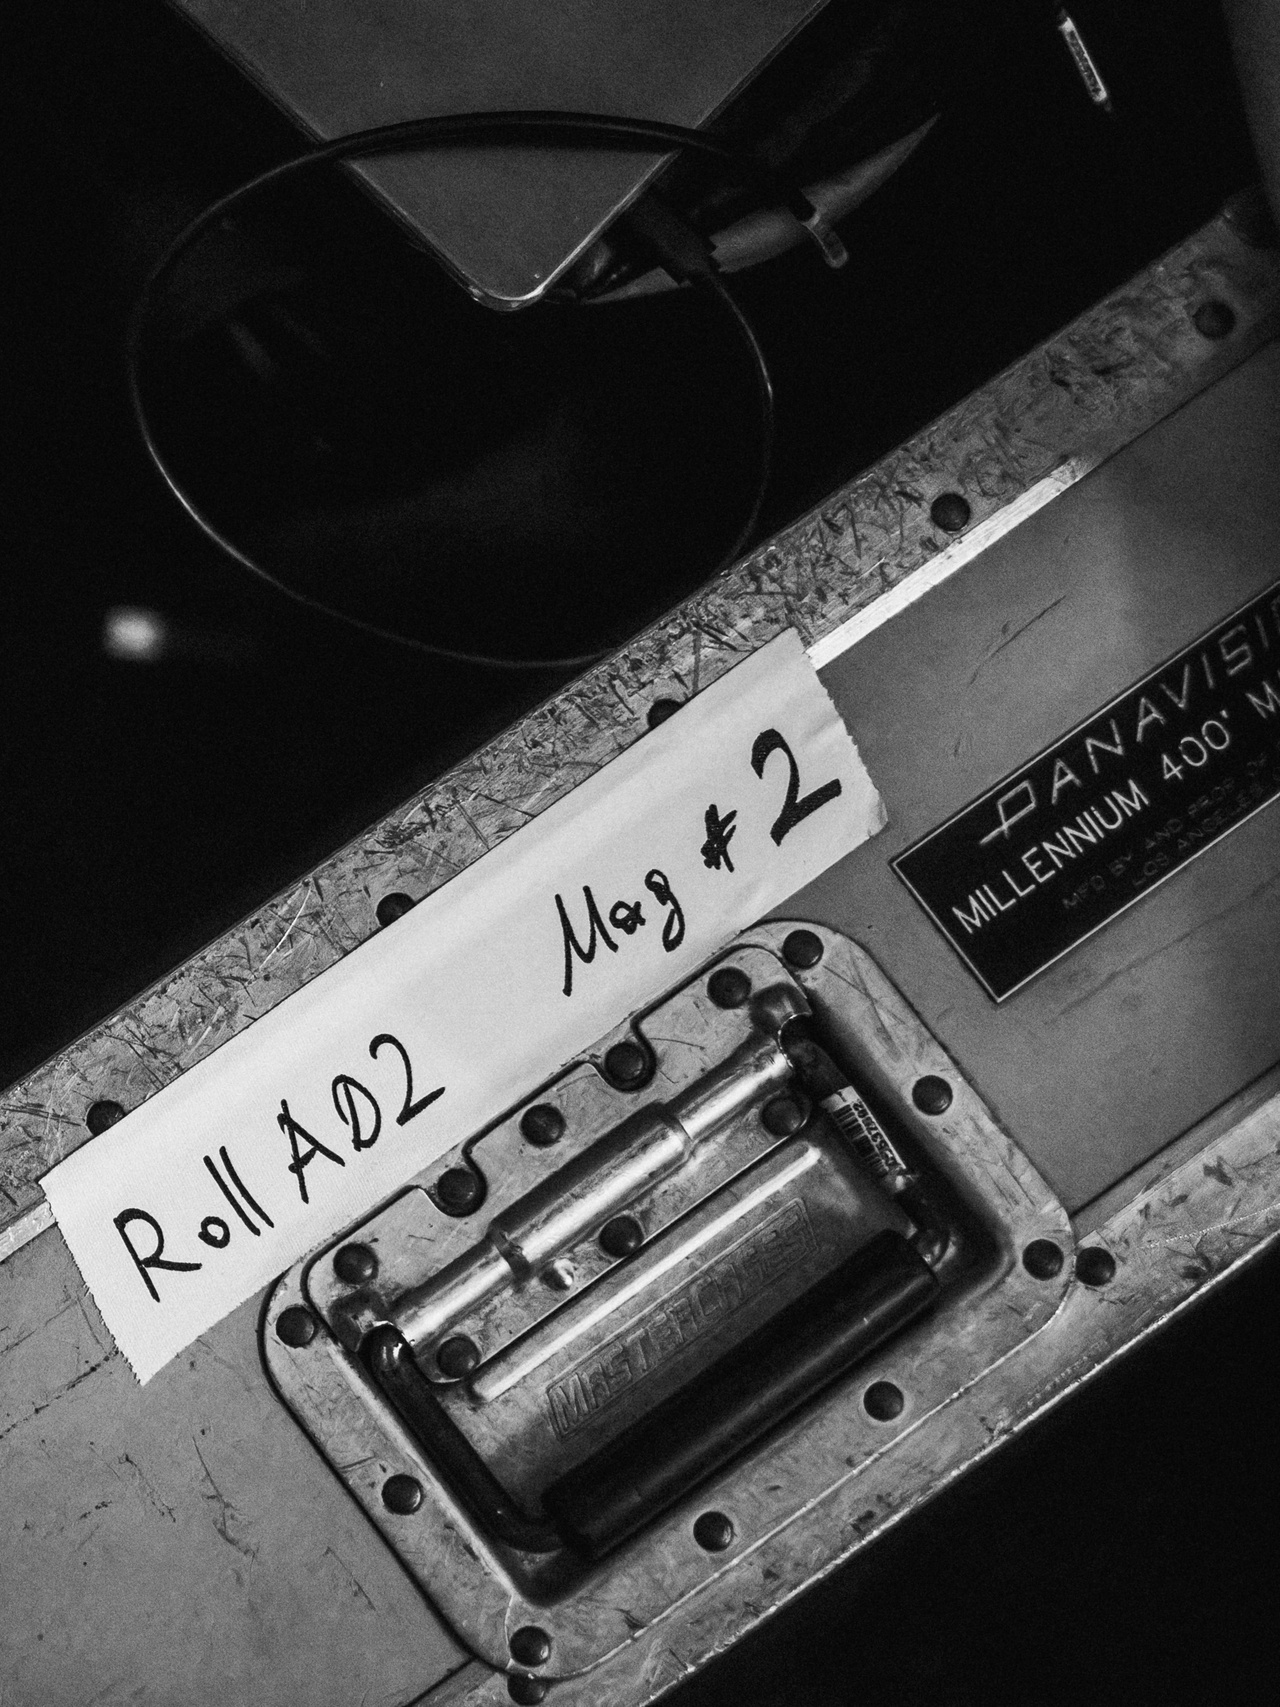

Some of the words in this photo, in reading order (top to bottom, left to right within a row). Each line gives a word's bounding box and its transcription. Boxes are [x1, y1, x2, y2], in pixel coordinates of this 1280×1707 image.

[554, 869, 688, 997] Mag
[951, 777, 1150, 934] MILLENNIUM
[1160, 708, 1230, 782] 400'
[1245, 668, 1280, 719] M
[113, 1144, 275, 1302] Roll
[277, 1033, 447, 1203] AD2
